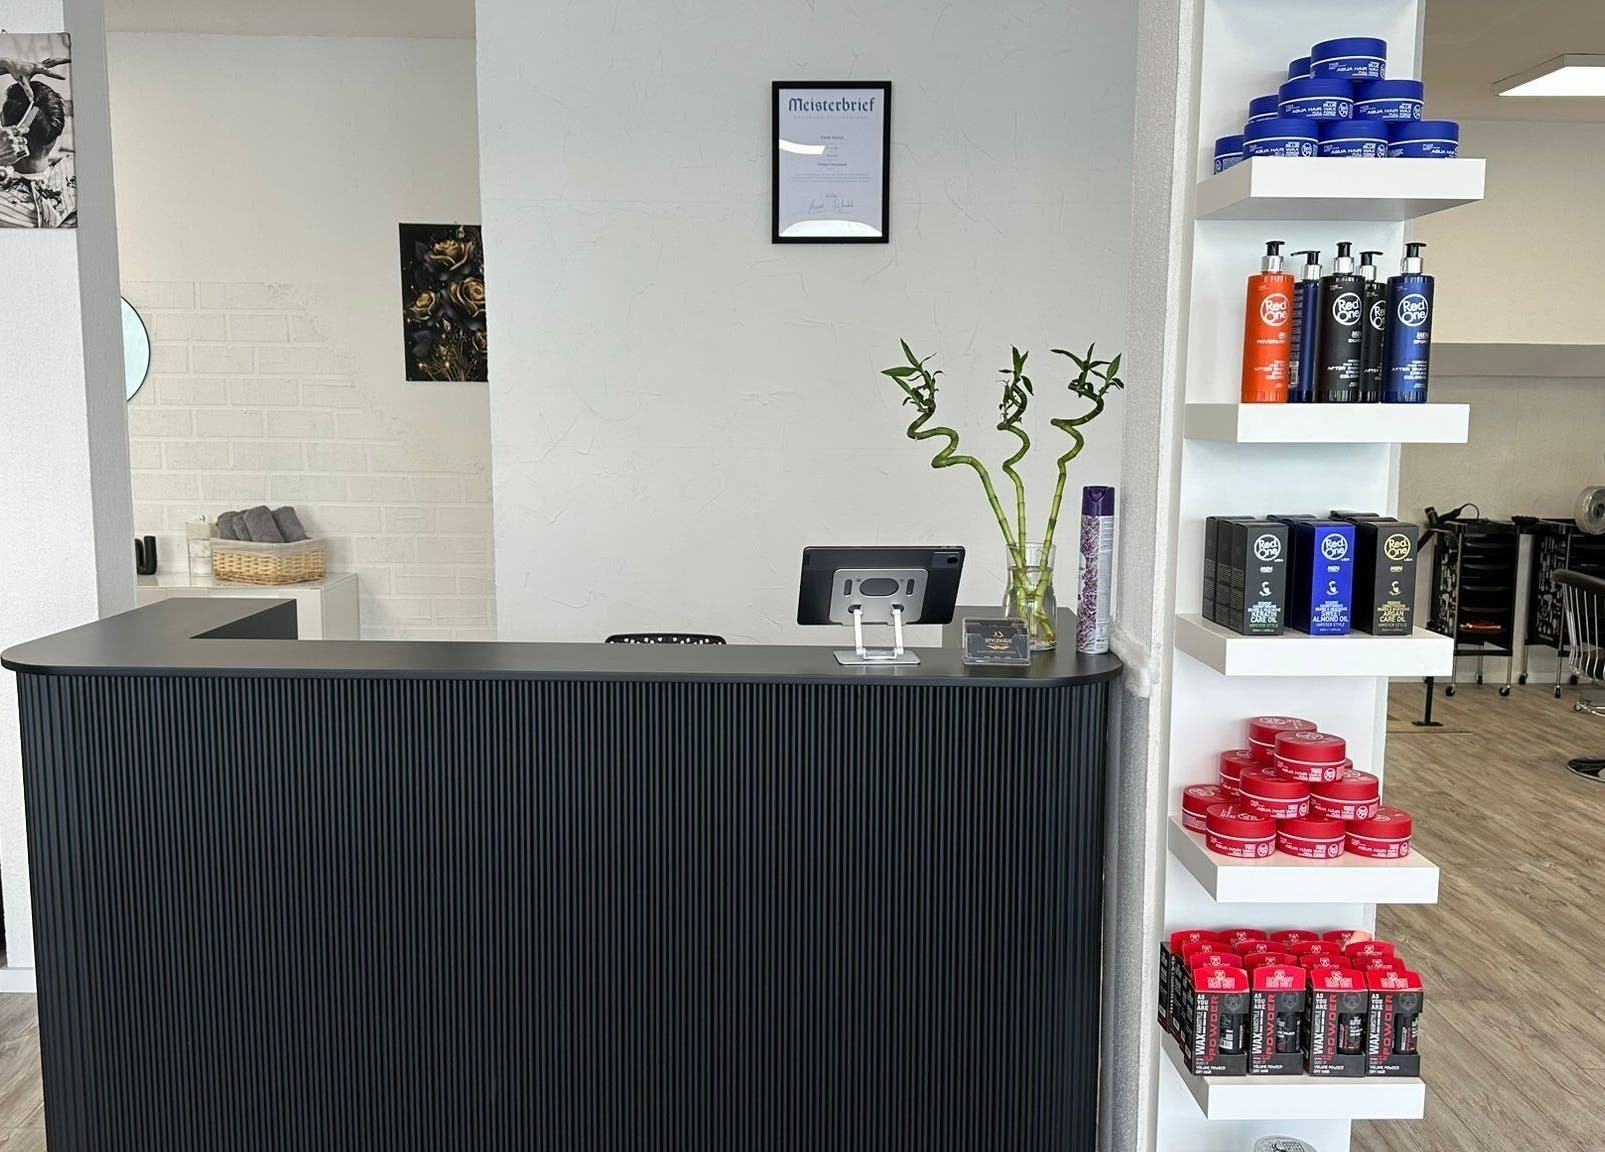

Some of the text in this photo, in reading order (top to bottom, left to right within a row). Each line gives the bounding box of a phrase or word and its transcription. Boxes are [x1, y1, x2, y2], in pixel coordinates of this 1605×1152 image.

[788, 97, 876, 112] Meisterbrief
[1266, 300, 1286, 311] Red
[1338, 299, 1358, 310] Red
[1403, 300, 1424, 311] Red
[1264, 310, 1287, 322] One
[1338, 310, 1360, 322] One
[1402, 311, 1426, 322] One
[1258, 540, 1277, 549] Red
[1326, 539, 1344, 548] Red
[1389, 540, 1407, 549] Red
[1258, 548, 1277, 557] One
[1325, 548, 1345, 557] One
[1388, 548, 1408, 557] One
[1209, 995, 1218, 1056] POWDER
[1266, 995, 1275, 1056] POWDER
[1326, 994, 1337, 1055] POWDER
[1383, 995, 1393, 1055] POWDER
[1195, 1033, 1205, 1055] WAX
[1252, 1033, 1262, 1054] WAX
[1313, 1033, 1323, 1054] WAX
[1369, 1033, 1379, 1054] WAX
